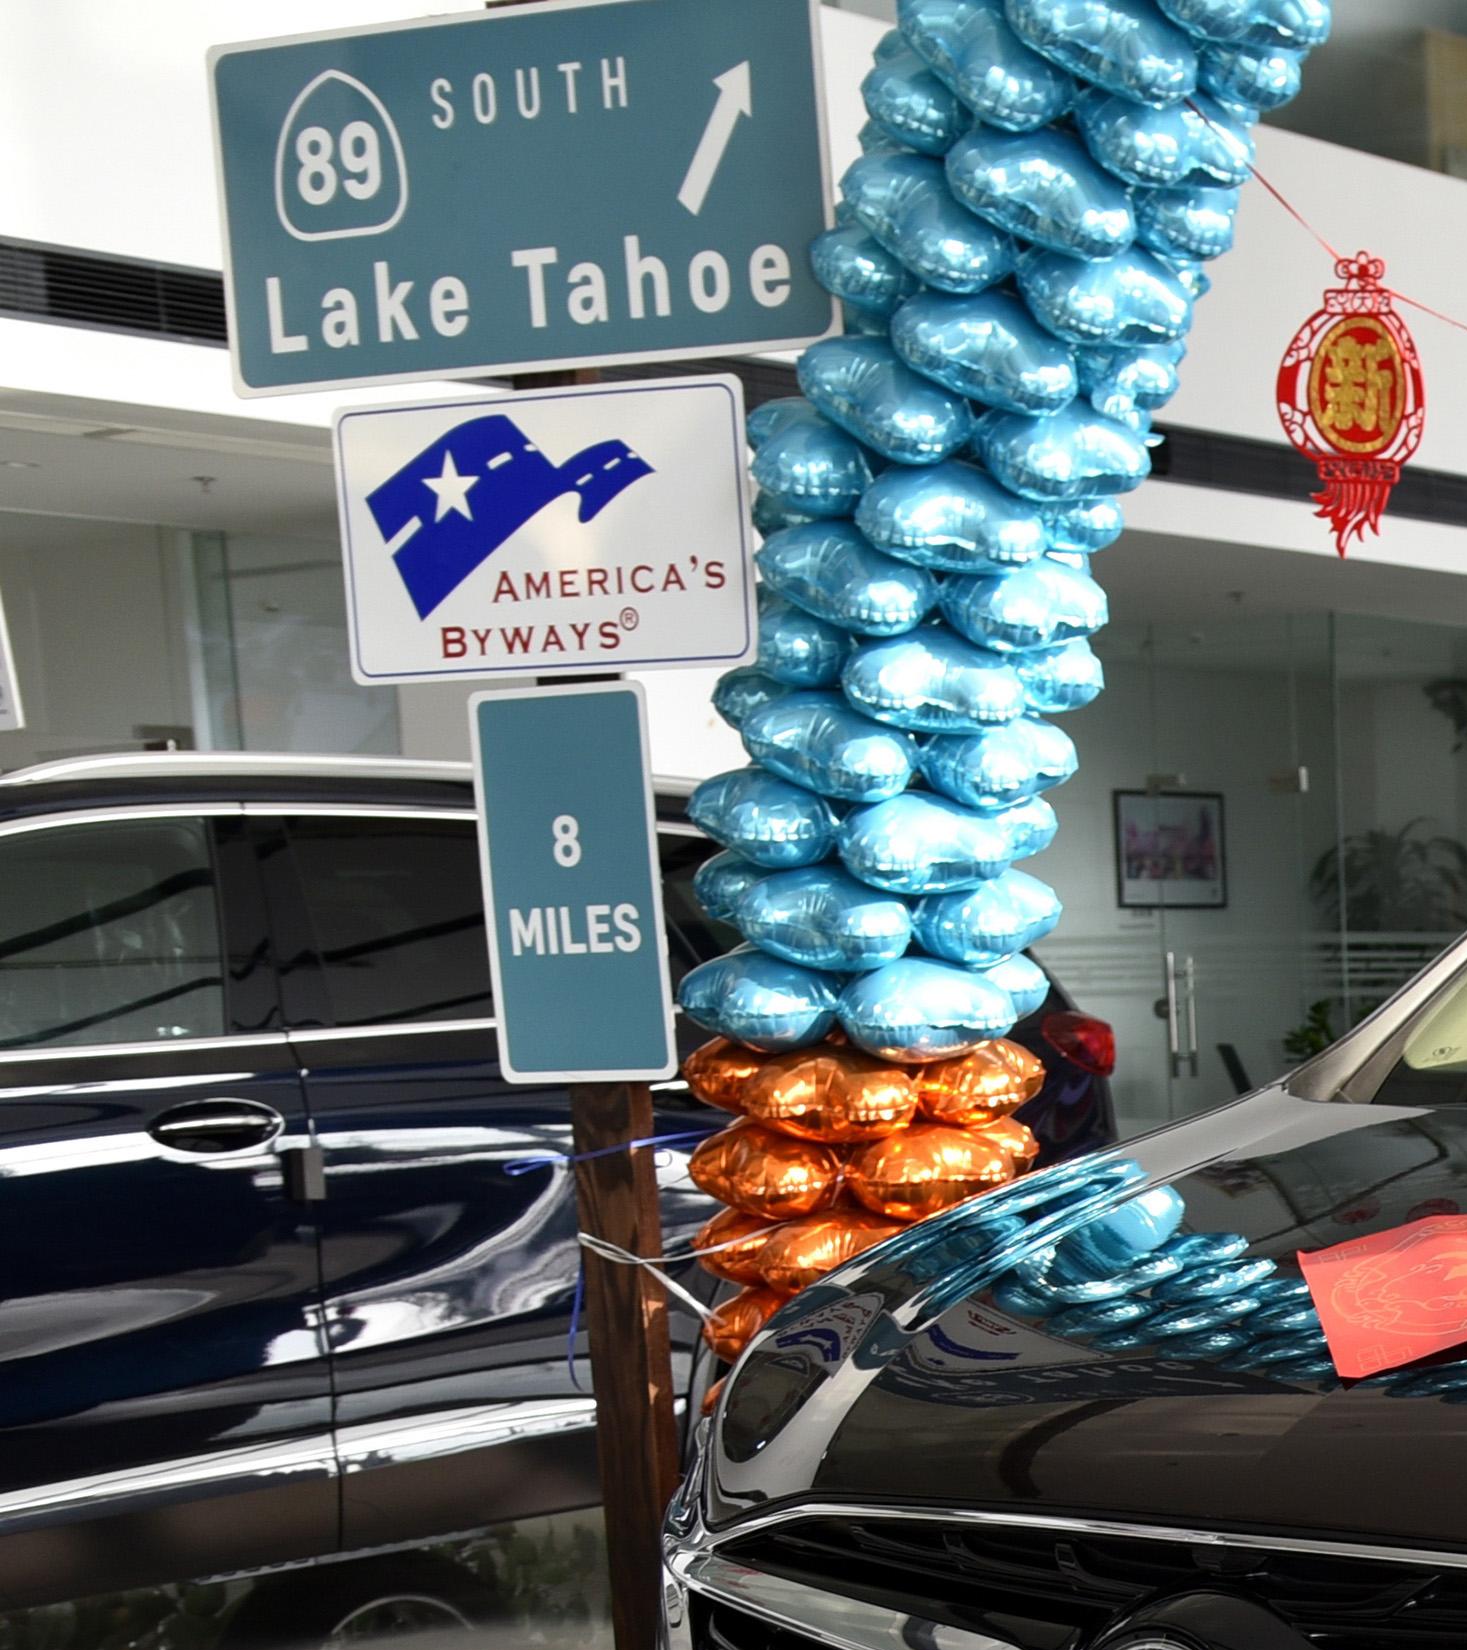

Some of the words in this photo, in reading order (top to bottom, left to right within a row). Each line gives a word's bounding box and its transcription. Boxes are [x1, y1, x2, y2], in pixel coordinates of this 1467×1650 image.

[430, 56, 629, 130] SOUTH
[295, 120, 382, 206] 89
[266, 261, 470, 355] Lake
[511, 235, 792, 328] Tahoe
[1324, 336, 1394, 434] 新
[492, 556, 728, 604] AMERICA'S
[551, 814, 583, 868] 8
[509, 903, 642, 956] MILES
